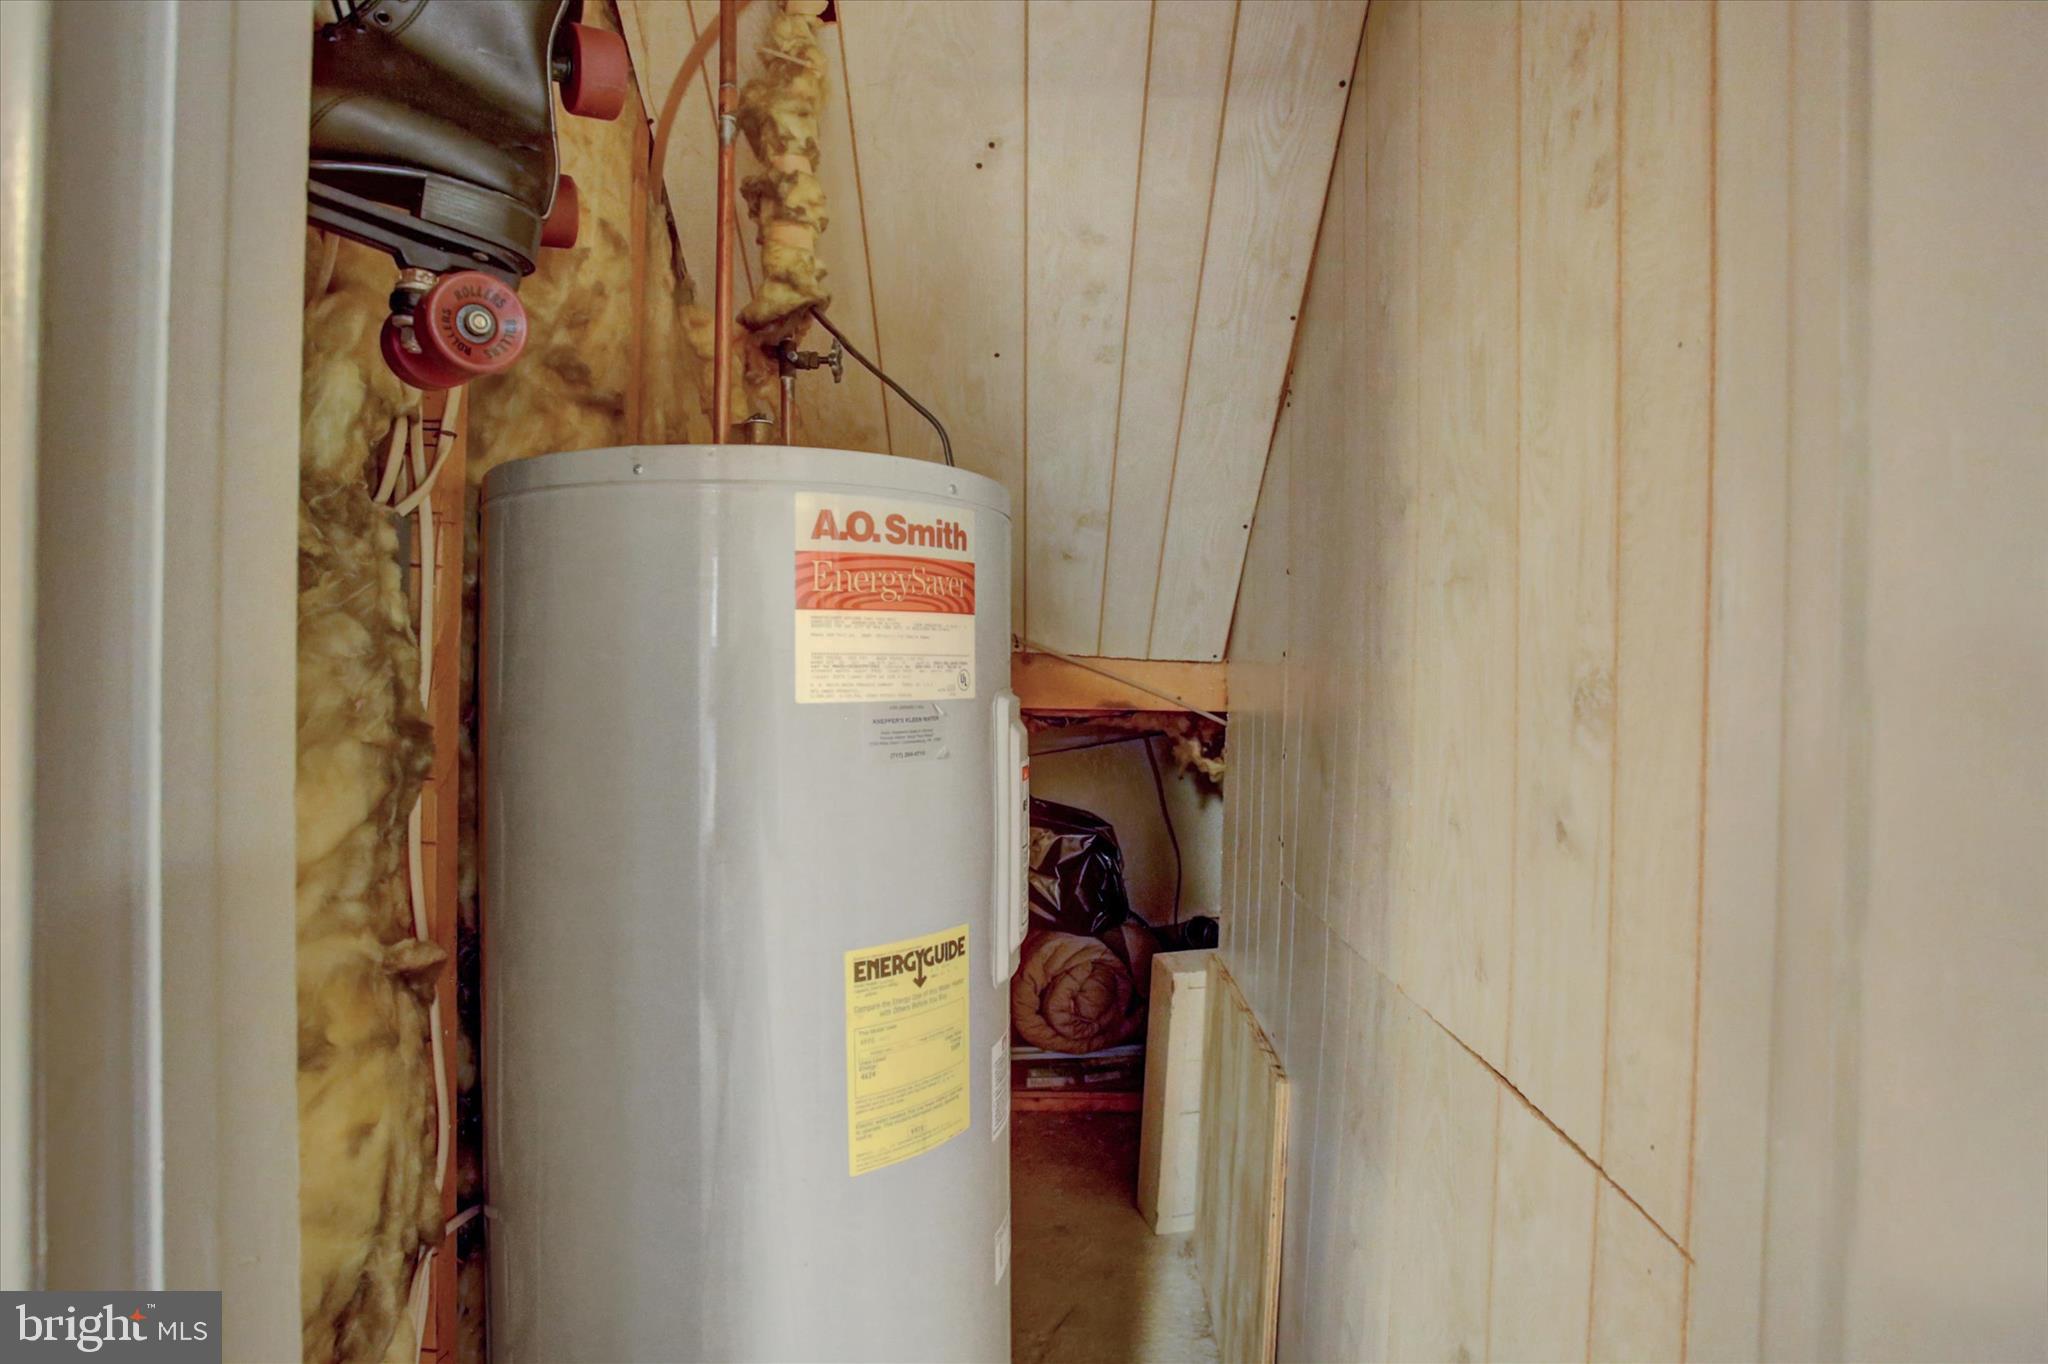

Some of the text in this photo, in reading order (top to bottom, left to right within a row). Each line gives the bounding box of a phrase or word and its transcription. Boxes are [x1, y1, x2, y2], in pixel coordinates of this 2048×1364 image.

[454, 285, 506, 308] ROLLERS
[811, 508, 968, 551] A.O. Smith
[854, 935, 966, 987] ENERGYGUIDE
